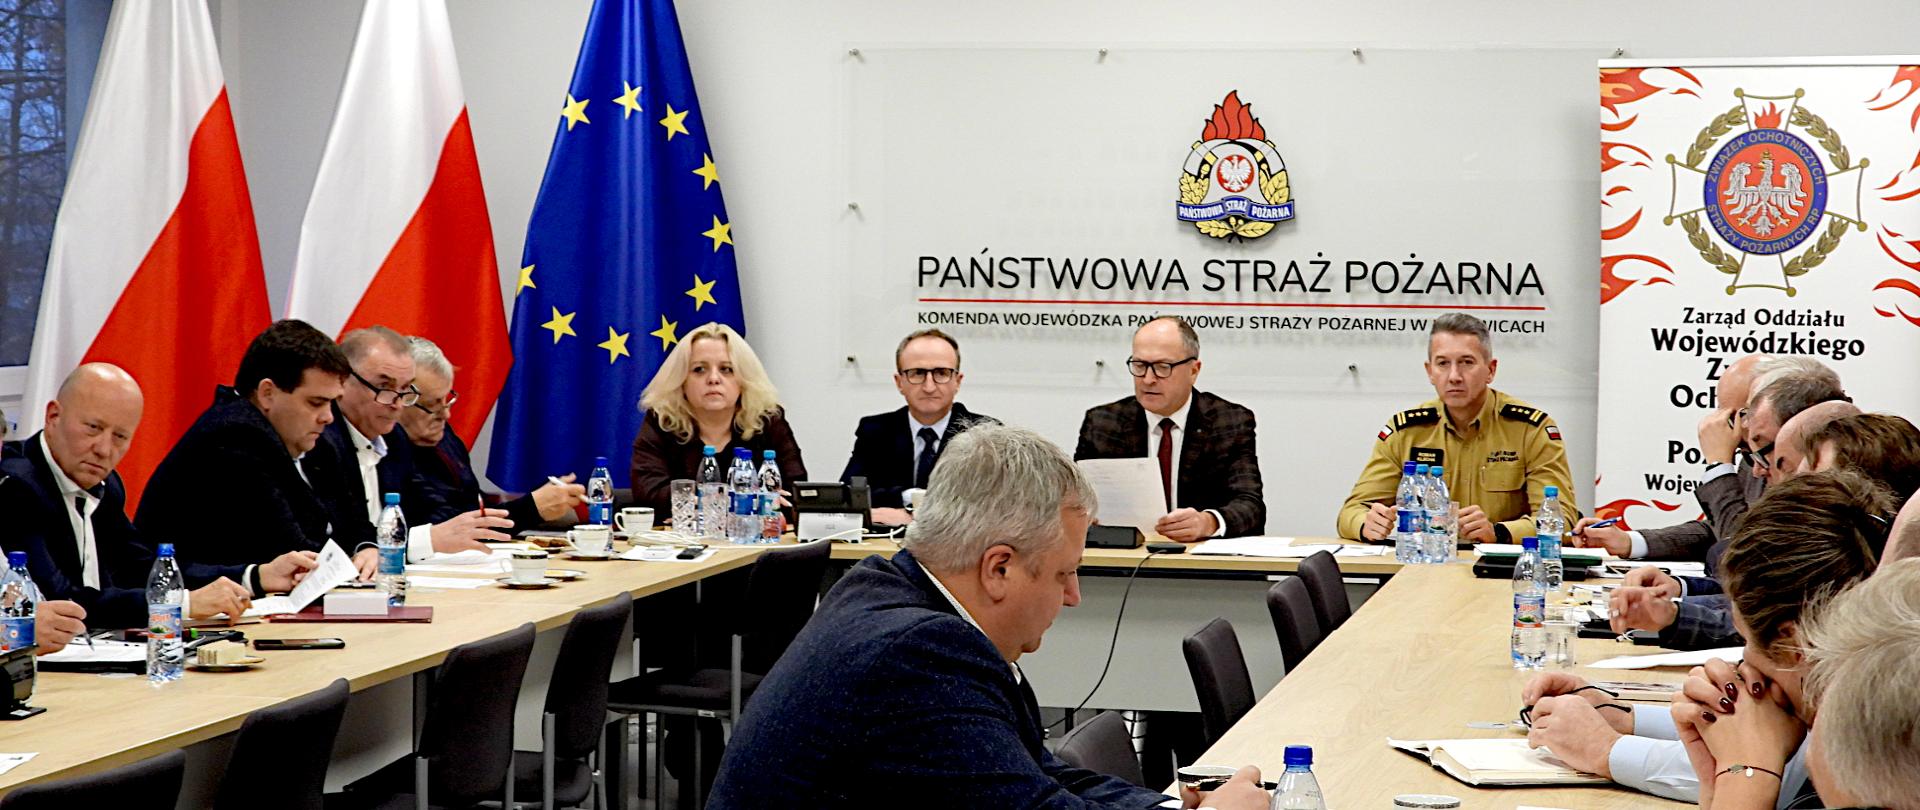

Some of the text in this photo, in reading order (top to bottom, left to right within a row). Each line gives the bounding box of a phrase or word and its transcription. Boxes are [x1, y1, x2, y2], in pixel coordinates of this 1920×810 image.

[1748, 131, 1825, 185] OCHOTNICZYCH
[1251, 206, 1290, 219] POŻARNA
[1807, 208, 1821, 226] RP
[918, 247, 1545, 296] PAŃSTWOWA STRAŻ POŻARNA
[918, 311, 1000, 325] KOMENDA
[1003, 309, 1123, 327] WOJEWÓDZKA
[1128, 311, 1244, 329] PAWOWEJ
[1410, 318, 1428, 331] W
[1682, 307, 1845, 330] Zarząd Oddziału
[1651, 328, 1865, 361] Wojewódzkiego
